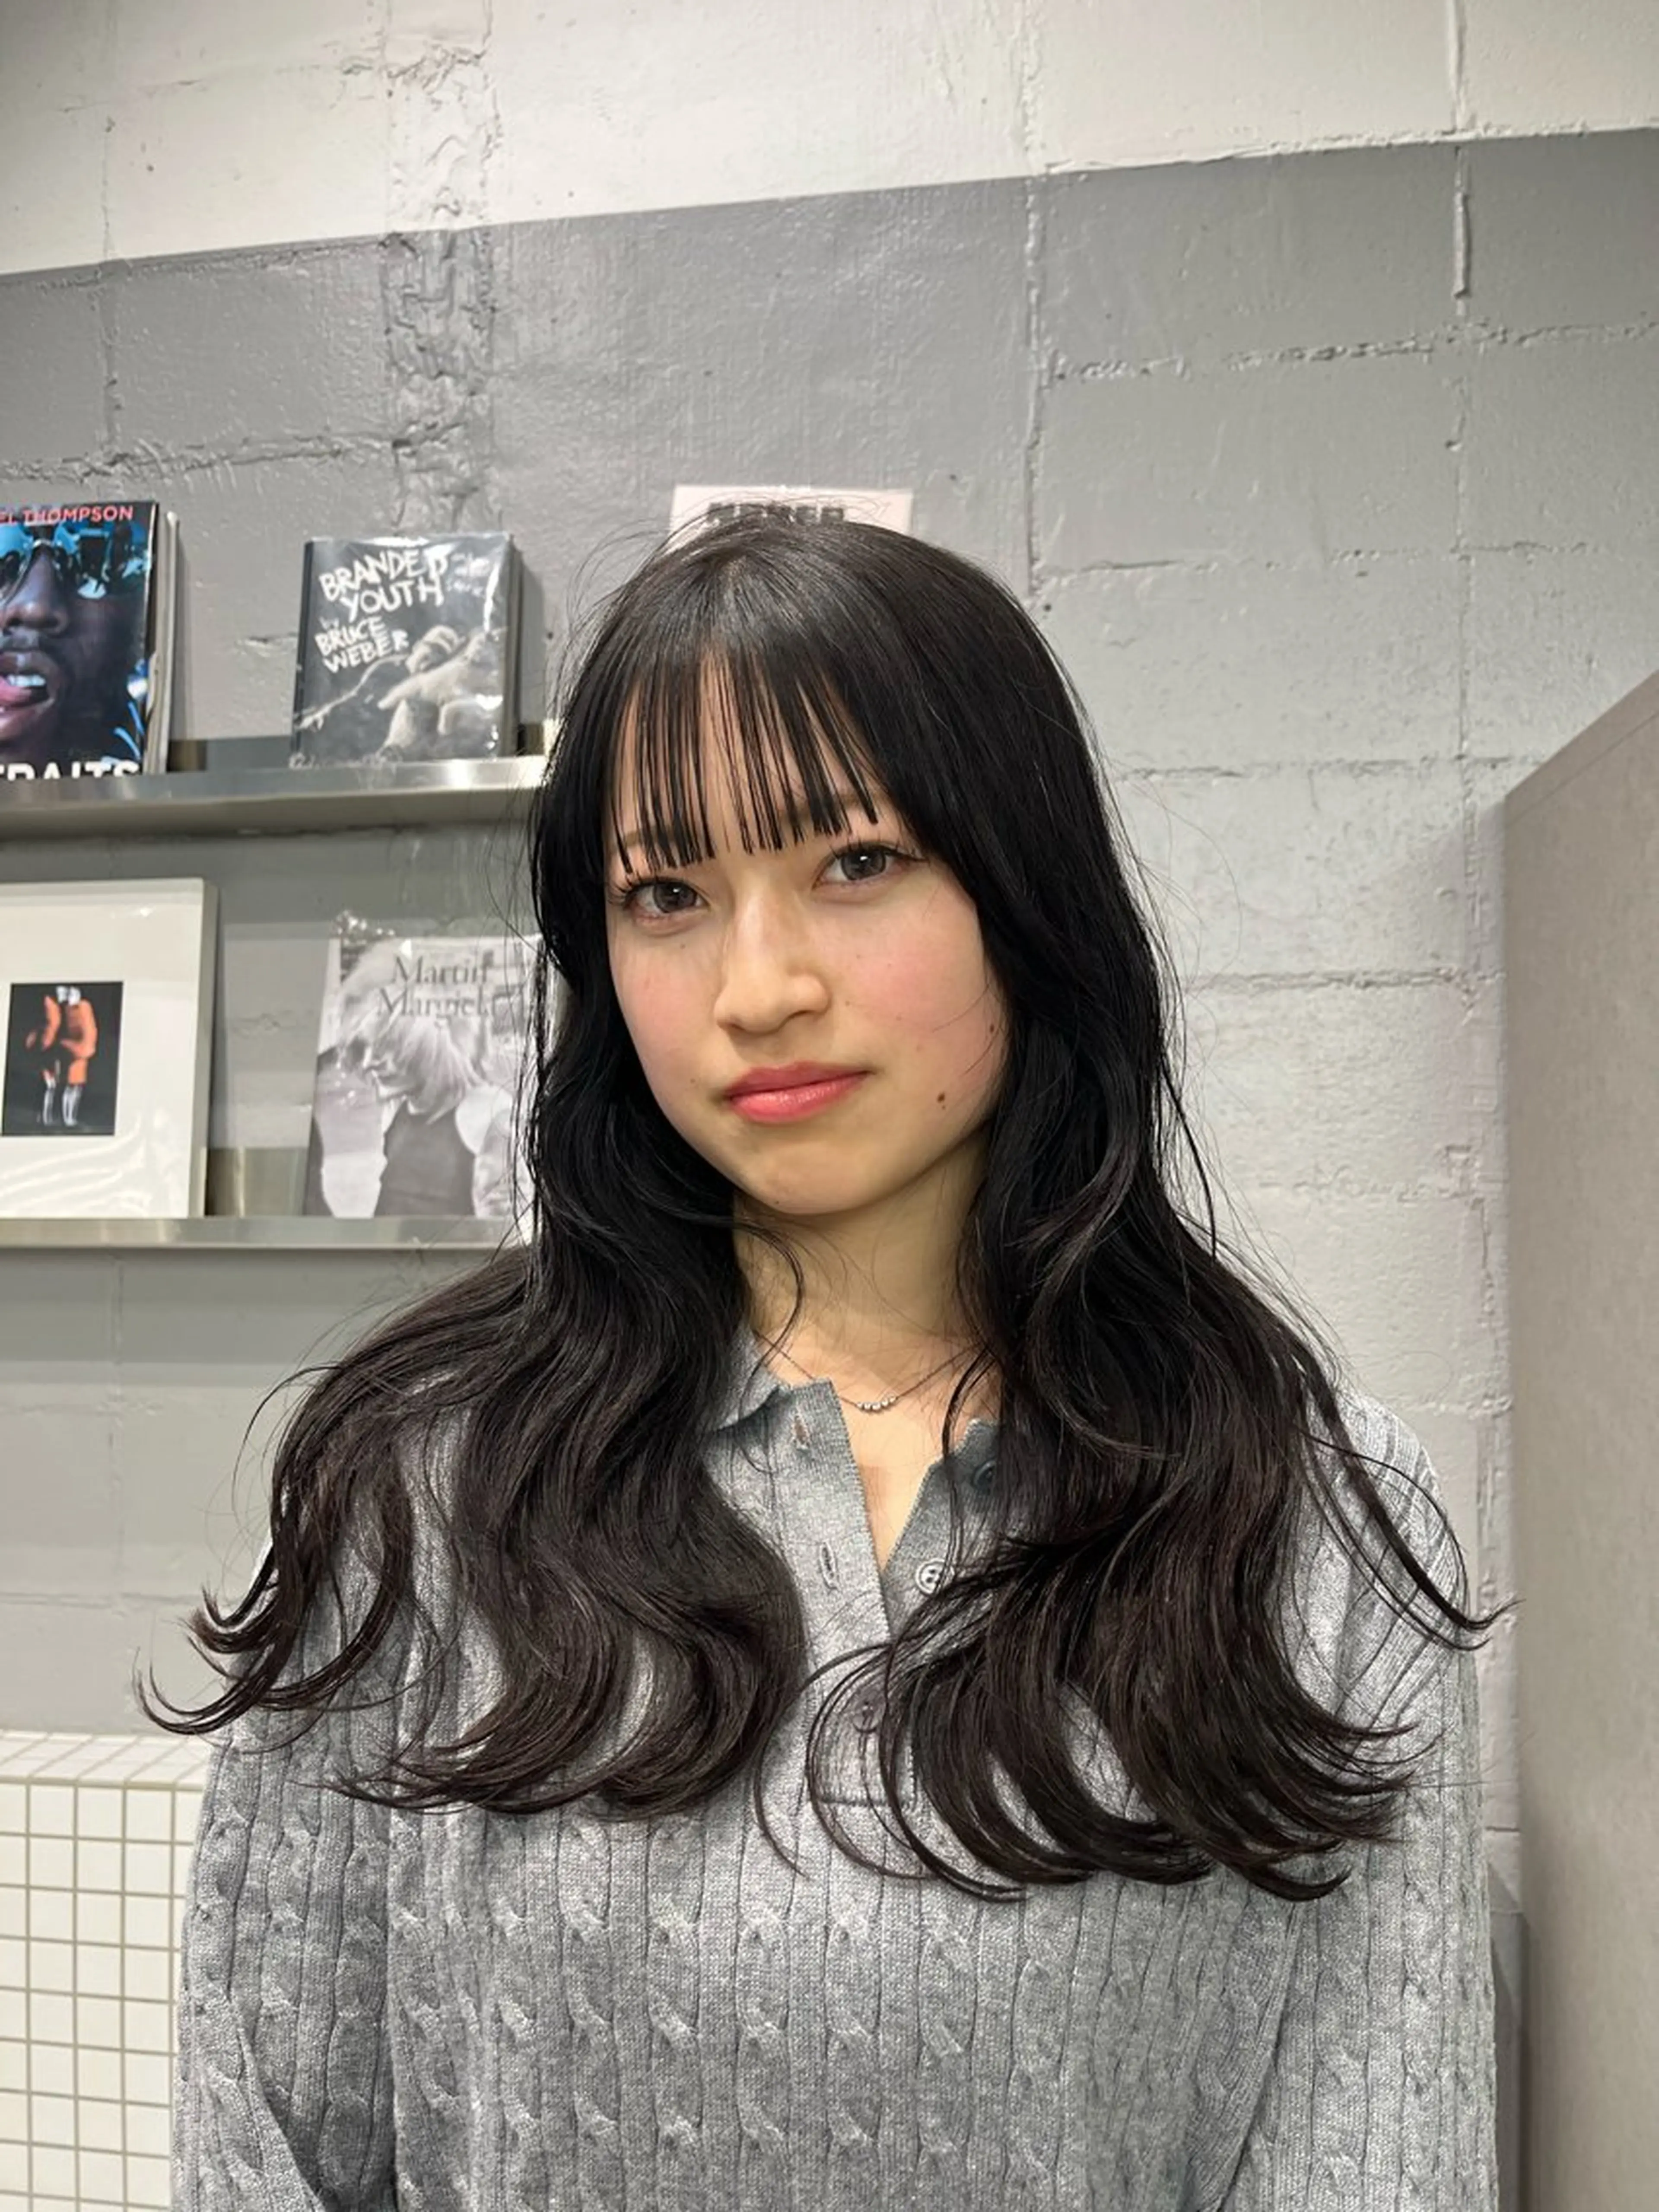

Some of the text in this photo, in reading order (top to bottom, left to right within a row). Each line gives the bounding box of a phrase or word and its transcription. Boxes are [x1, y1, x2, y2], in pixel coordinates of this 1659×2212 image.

[23, 505, 133, 526] THOMPSON
[319, 549, 449, 601] BRANDED
[340, 576, 444, 623] YOUTH
[315, 616, 386, 656] BRUCE
[323, 629, 409, 673] WEBER
[392, 955, 488, 983] Martin
